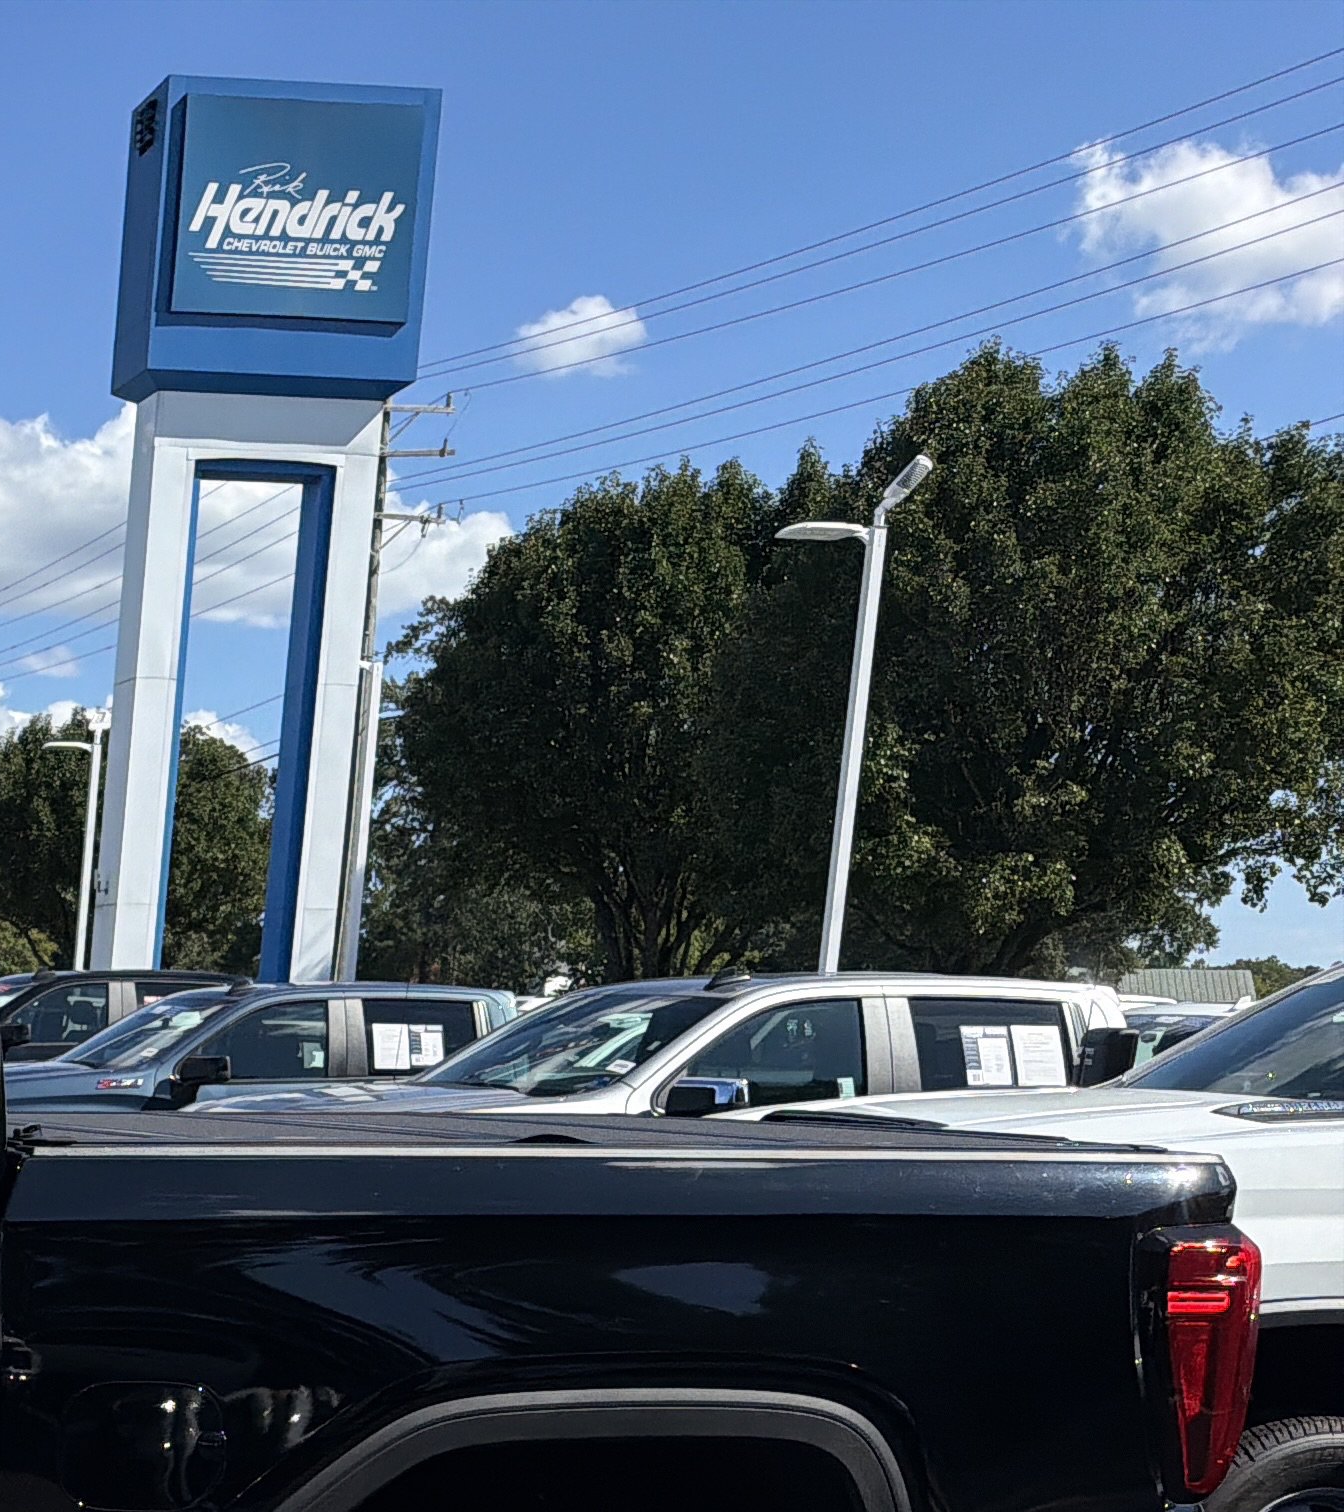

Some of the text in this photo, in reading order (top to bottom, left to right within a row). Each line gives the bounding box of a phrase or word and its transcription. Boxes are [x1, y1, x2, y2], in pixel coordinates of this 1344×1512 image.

[189, 182, 406, 249] Hendrick
[222, 237, 386, 258] CHEVROLET BUICK GMC
